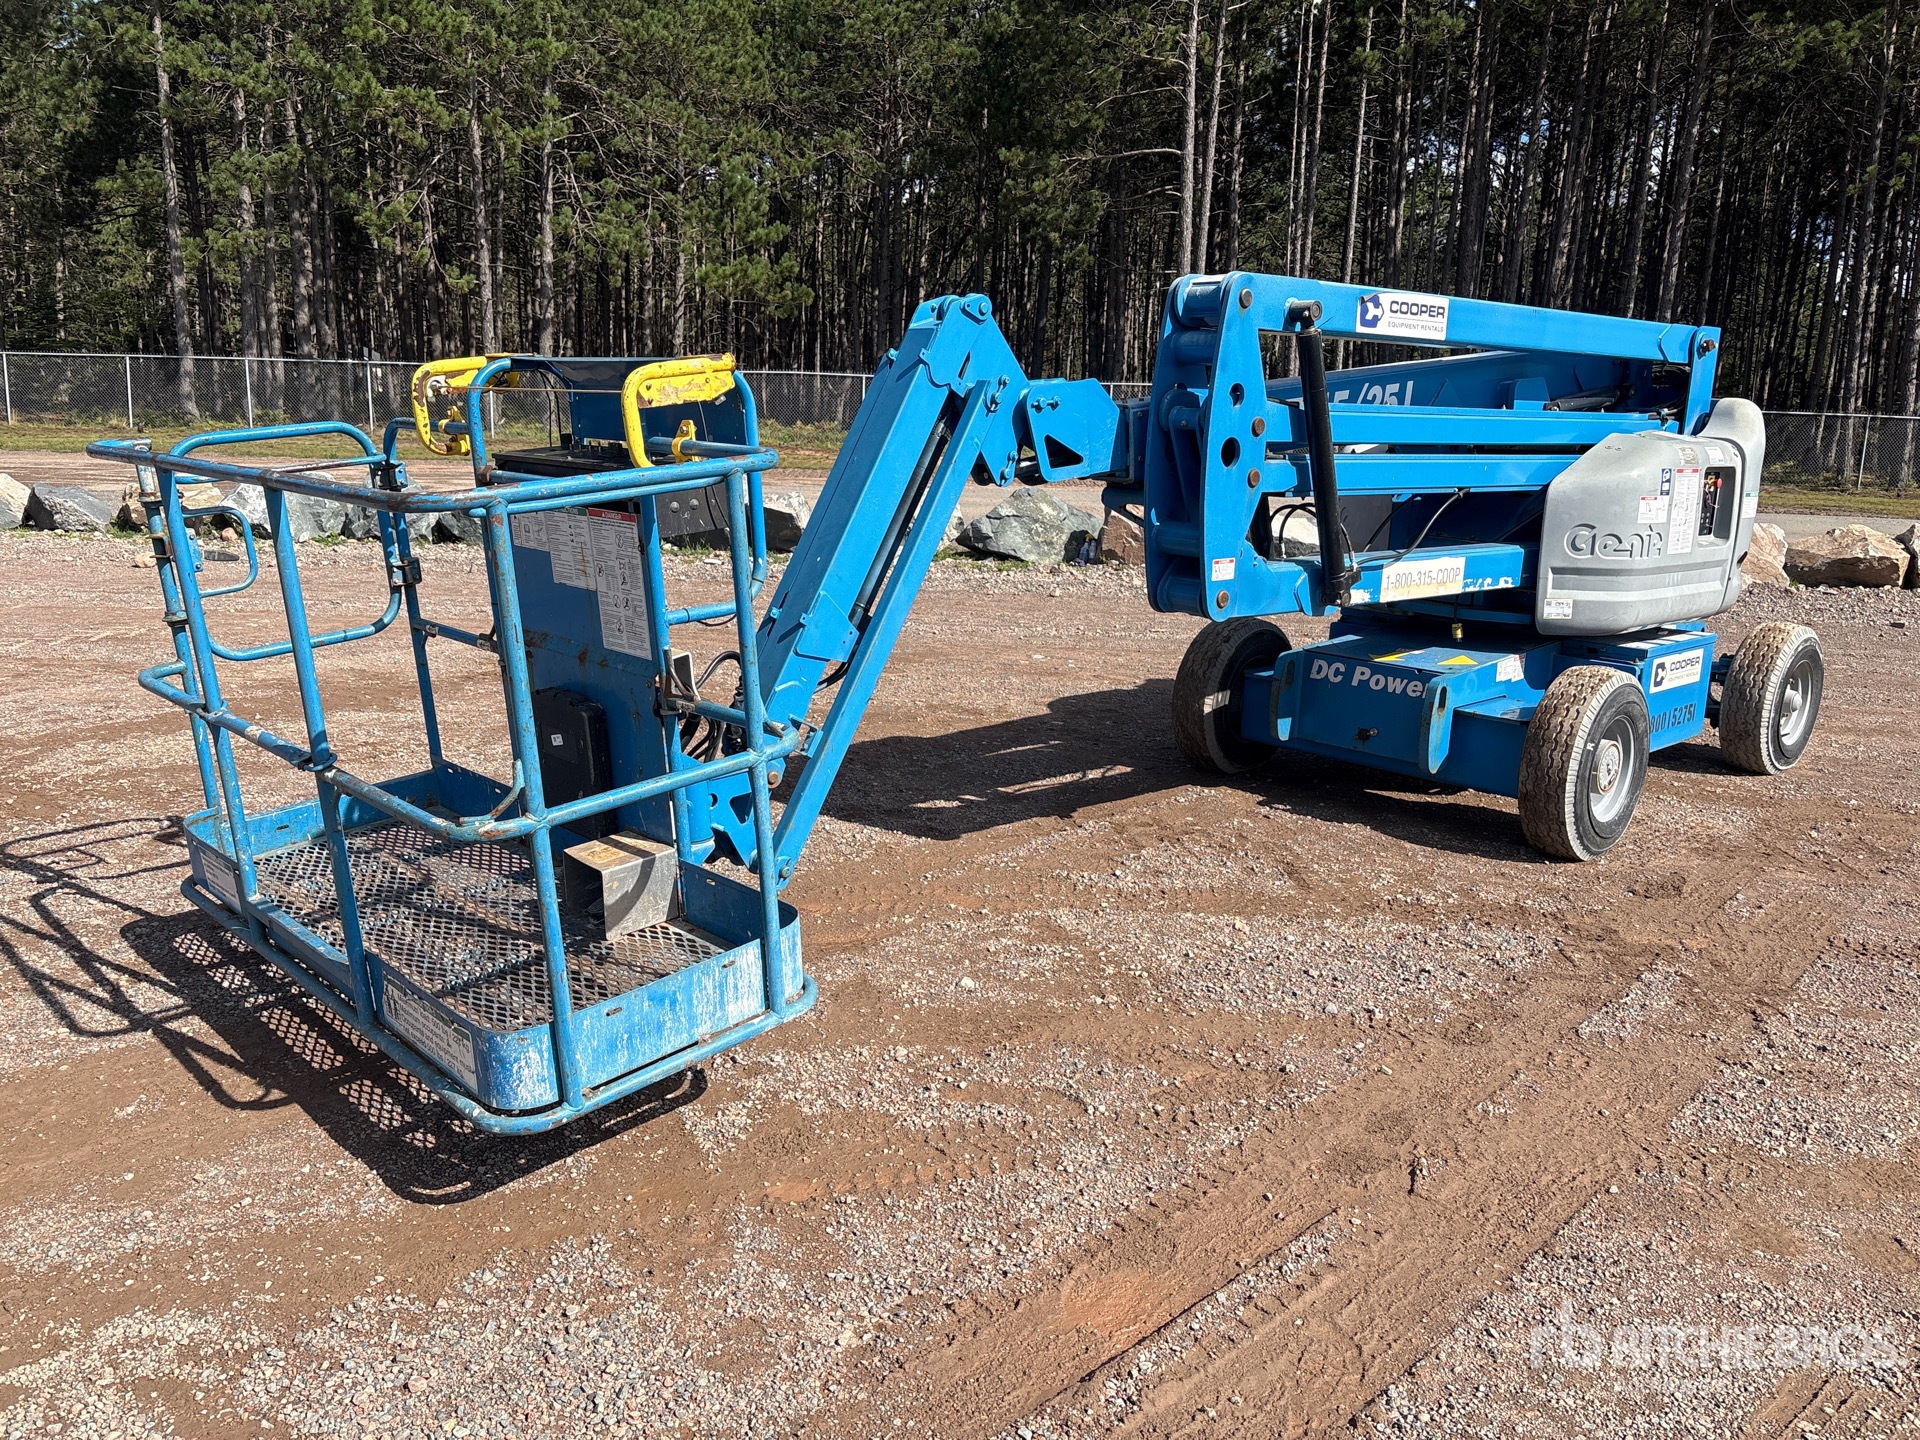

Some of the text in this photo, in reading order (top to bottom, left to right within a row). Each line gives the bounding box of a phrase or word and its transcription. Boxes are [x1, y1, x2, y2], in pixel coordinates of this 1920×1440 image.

[1389, 300, 1446, 319] COOPER
[1387, 321, 1444, 333] EQUIPMENT RENTALS
[1564, 523, 1663, 560] Genie
[1386, 567, 1461, 590] 1-800-315-COOP
[1310, 658, 1345, 683] DC
[1669, 656, 1700, 671] COOPER
